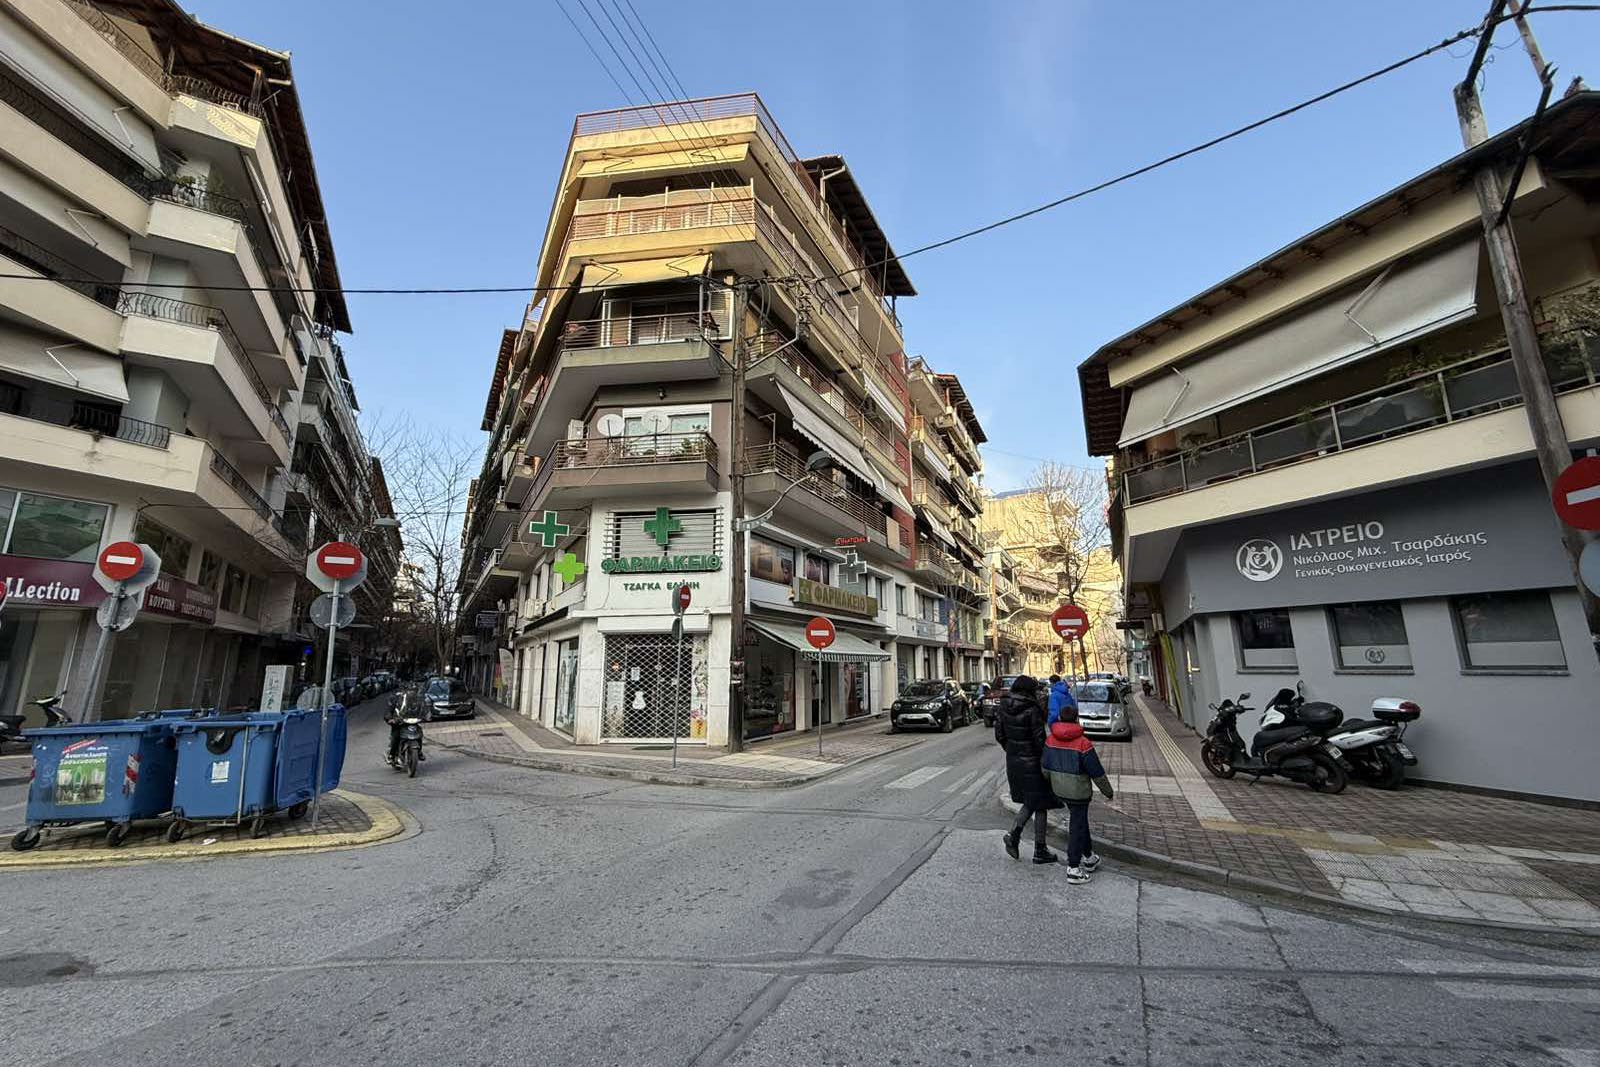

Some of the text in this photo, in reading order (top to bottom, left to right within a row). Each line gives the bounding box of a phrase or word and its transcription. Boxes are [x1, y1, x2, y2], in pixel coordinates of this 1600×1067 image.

[1290, 521, 1384, 550] ΙΑΤΡΕΙΟ
[1293, 531, 1487, 566] Νικόλαος Μιχ. Τσαρδάκης
[601, 554, 721, 574] ΦΑΡΜΑΚΕΙΟ
[1295, 550, 1472, 578] Γενικός-Οικογενειακός Ιατρός
[624, 582, 661, 591] ΤΖΑΓΚΑ
[814, 583, 866, 612] ΦΑΡΜΑΚΕΙΟ
